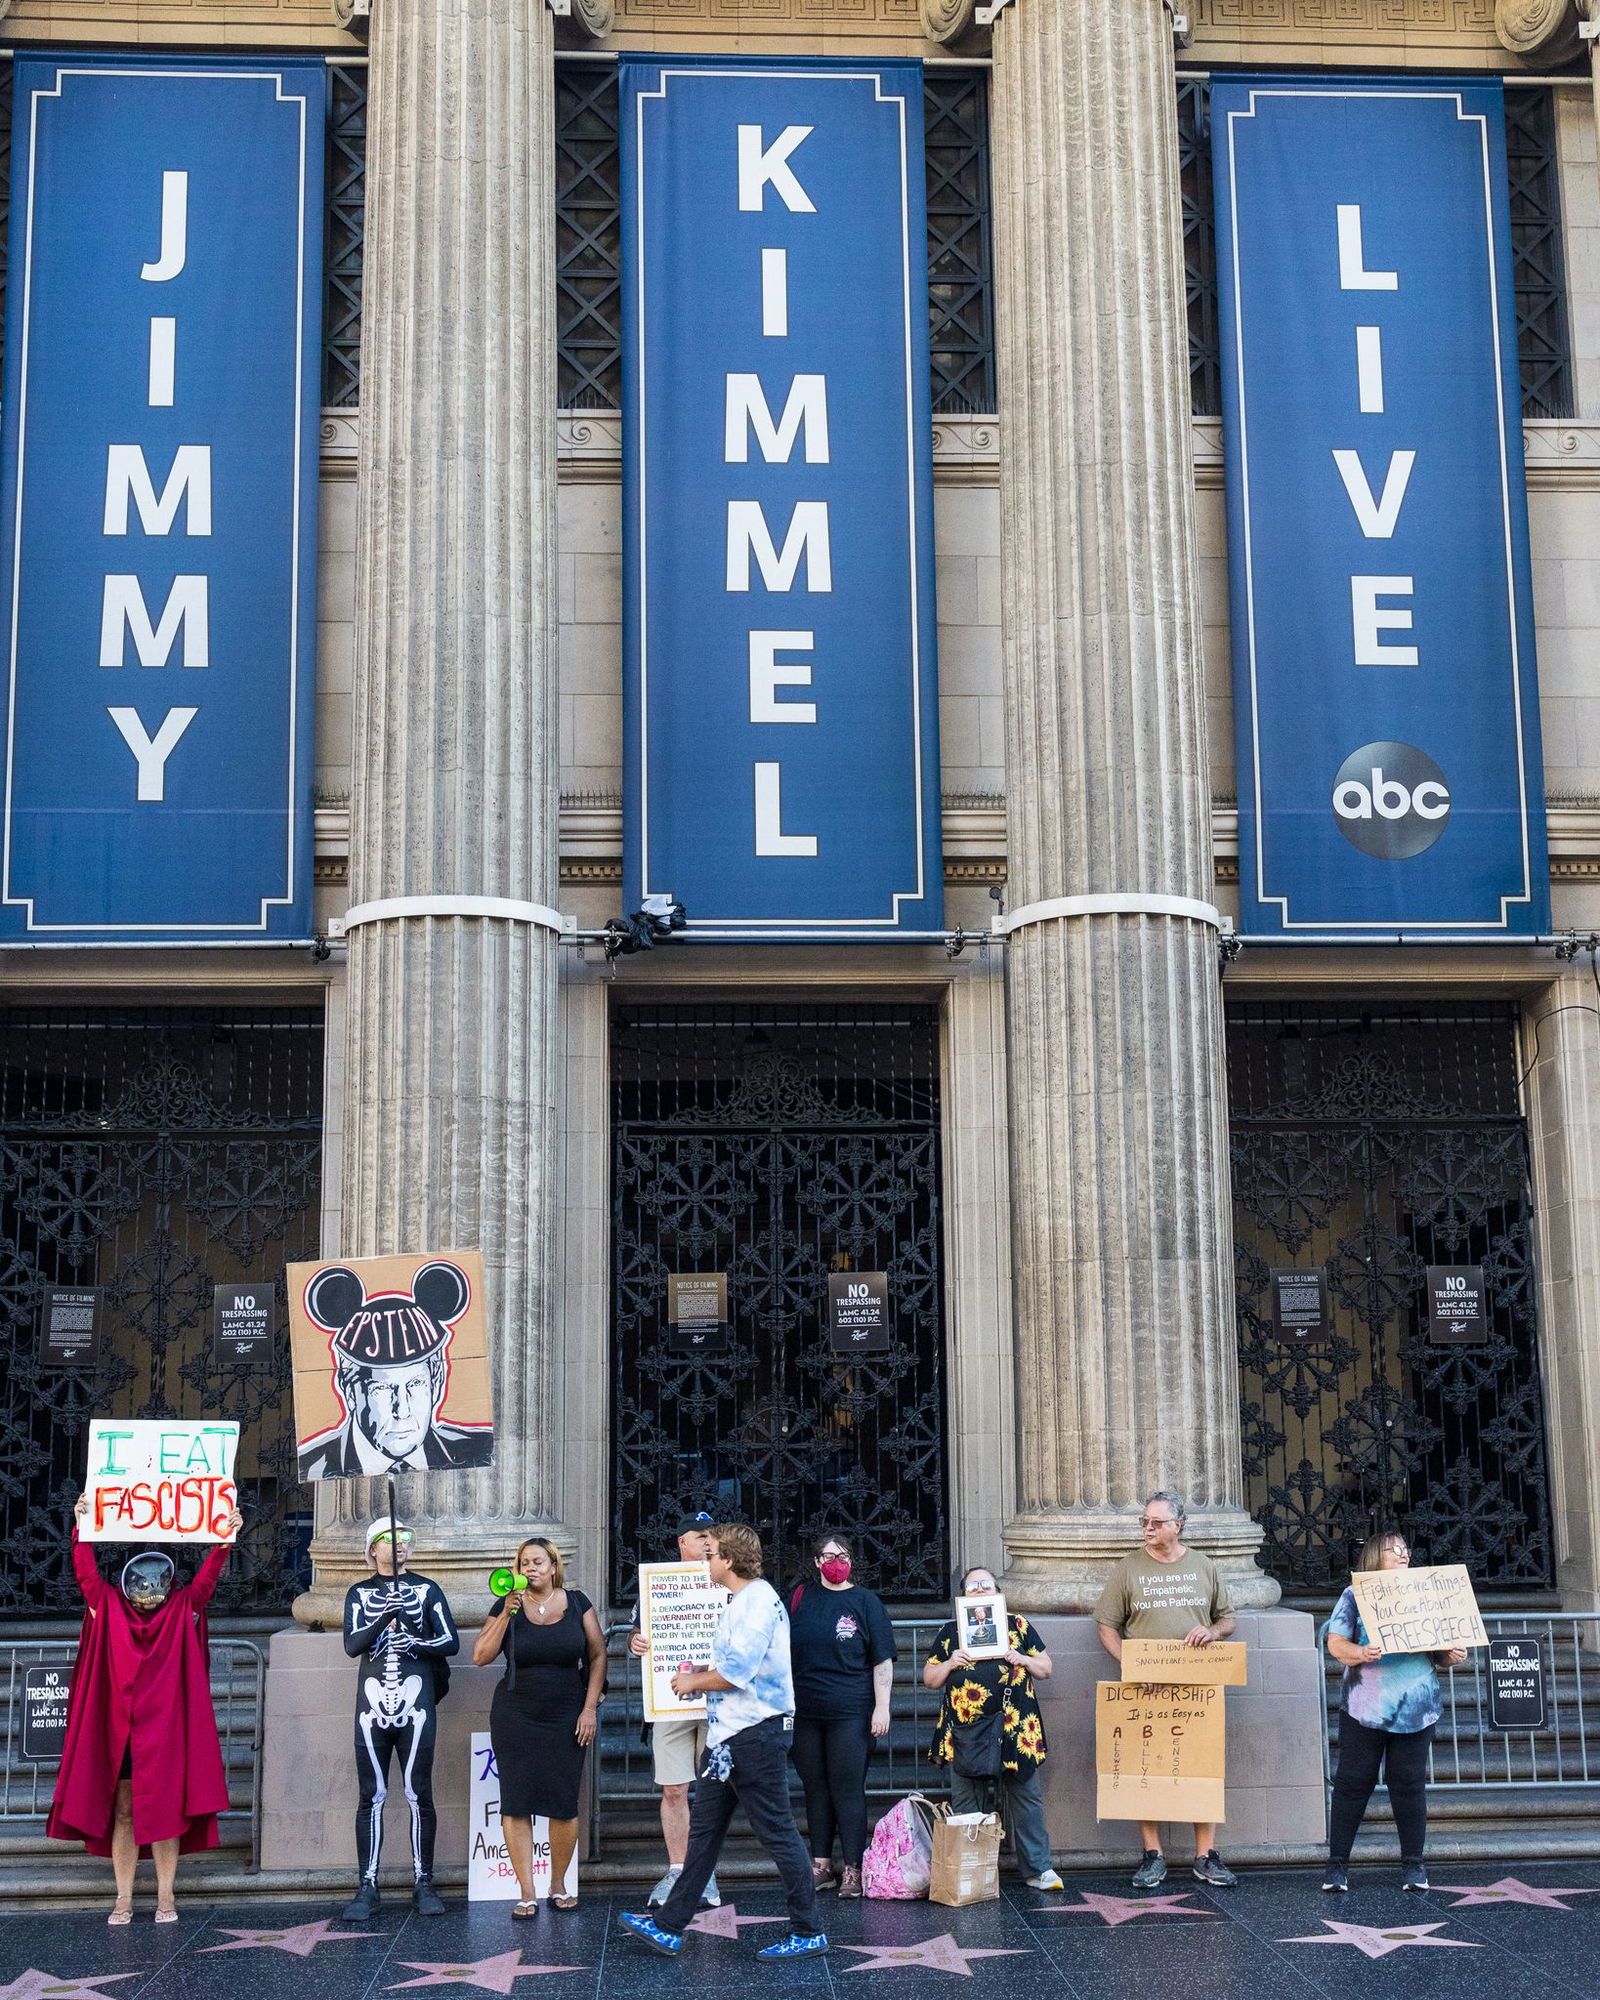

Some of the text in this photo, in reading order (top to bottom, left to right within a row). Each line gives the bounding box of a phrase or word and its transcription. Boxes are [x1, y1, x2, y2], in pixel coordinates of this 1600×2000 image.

[1333, 205, 1418, 665] LIVE
[100, 172, 211, 800] JIMMY
[724, 125, 831, 855] KIMMEL
[1333, 768, 1450, 819] abc
[700, 1281, 719, 1289] FILMING
[1445, 1276, 1466, 1290] NO
[848, 1283, 869, 1298] NO
[1435, 1290, 1478, 1298] TRESPASSING
[69, 1294, 76, 1302] OF
[234, 1296, 256, 1310] NO
[836, 1298, 881, 1306] TRESPASSING
[1437, 1301, 1478, 1309] LAMC 41.24
[221, 1310, 268, 1318] TRESPASSING
[339, 1306, 439, 1358] EPSTEIN
[97, 1427, 237, 1475] I EAT
[94, 1477, 236, 1540] FASCISTS
[1138, 1572, 1198, 1586] If you are not
[1426, 1572, 1467, 1596] Things
[659, 1603, 706, 1613] DEMOCRACY
[1133, 1600, 1151, 1611] You
[1152, 1599, 1168, 1608] are
[1371, 1602, 1394, 1621] You
[651, 1613, 702, 1622] GOVERNMENT
[654, 1644, 687, 1652] AMERICA
[1507, 1645, 1520, 1658] NO
[1491, 1659, 1540, 1671] TRESPASSING
[45, 1673, 59, 1686] NO
[1498, 1679, 1515, 1688] LAMC
[1499, 1689, 1535, 1698] 602 (10) P.C.
[32, 1707, 51, 1717] LAMC
[1145, 1709, 1154, 1720] is
[1158, 1711, 1168, 1719] as
[1172, 1708, 1192, 1724] Easy
[1194, 1710, 1205, 1718] as
[32, 1720, 45, 1728] 602
[46, 1719, 58, 1728] (10)
